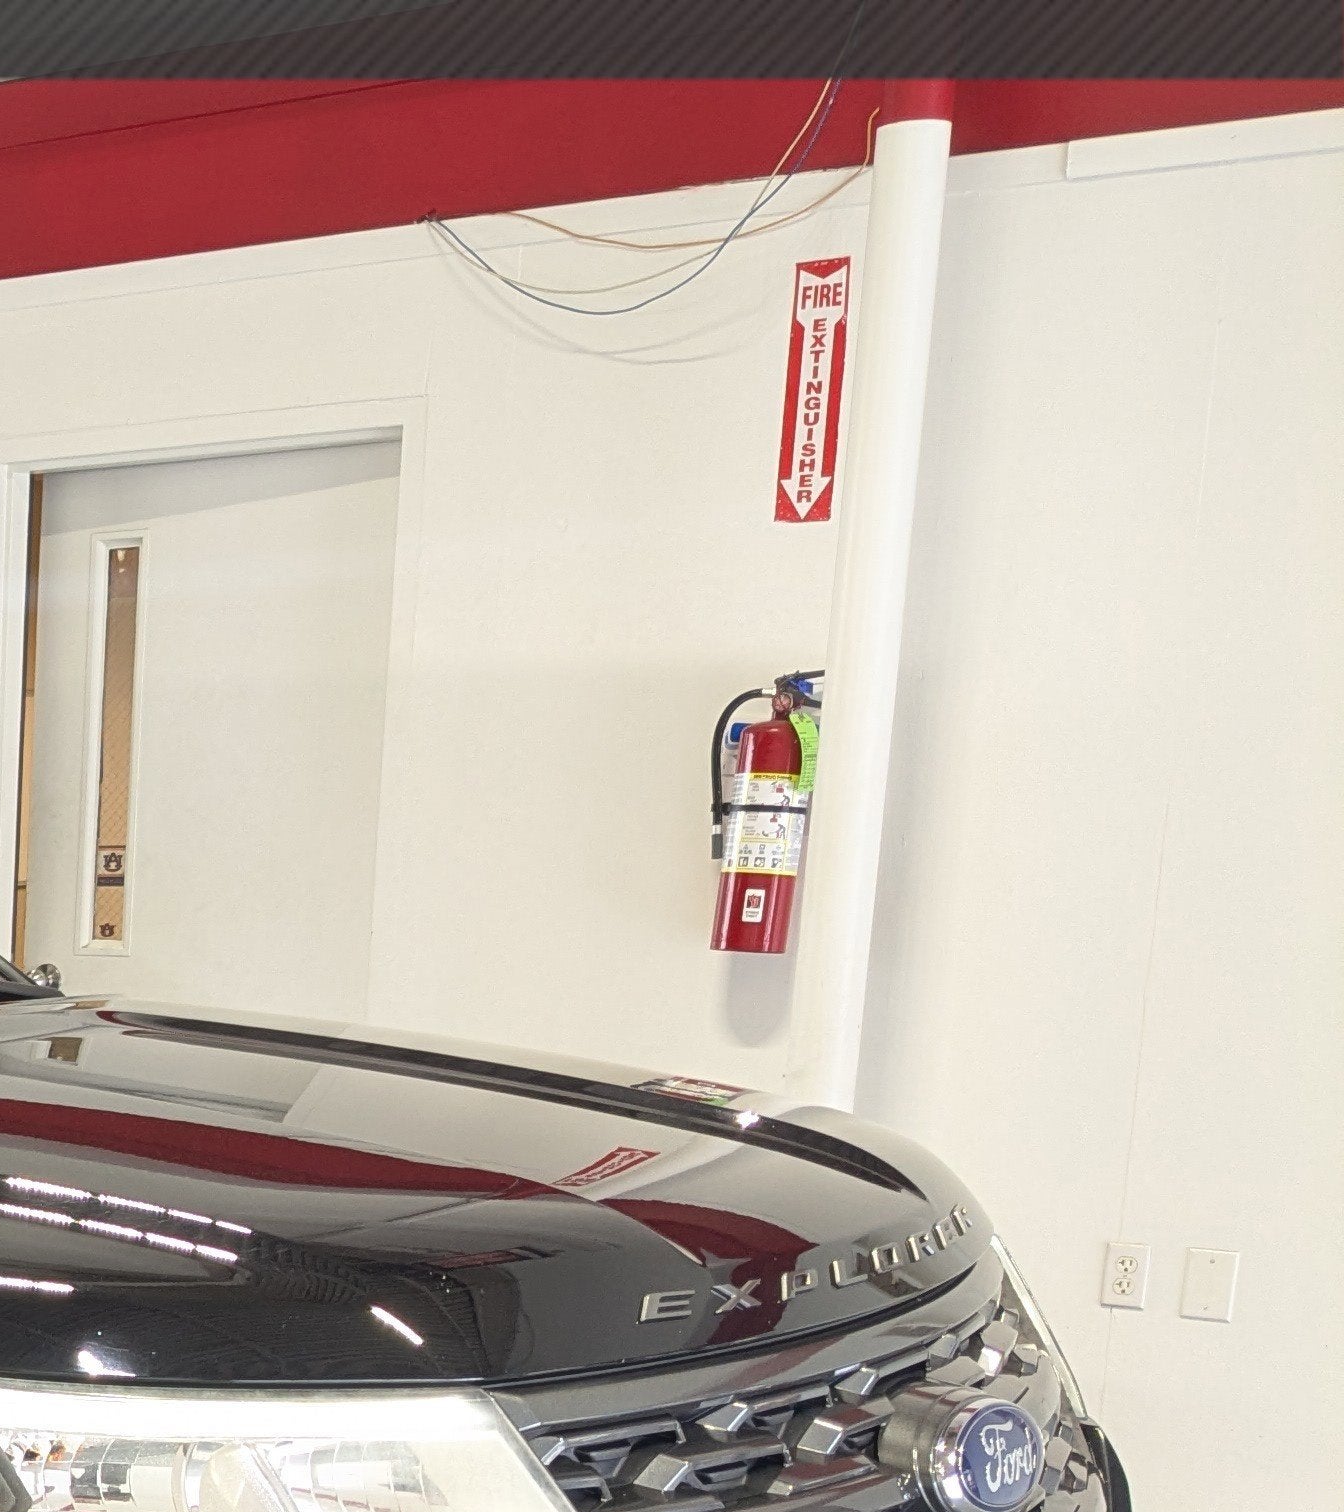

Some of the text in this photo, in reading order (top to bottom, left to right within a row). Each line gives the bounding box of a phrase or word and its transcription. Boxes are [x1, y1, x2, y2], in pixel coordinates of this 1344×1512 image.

[801, 282, 843, 311] FIRE
[797, 317, 828, 504] EXTINGUISHER
[637, 1204, 973, 1324] EXPLORER
[979, 1419, 1038, 1493] Ford
